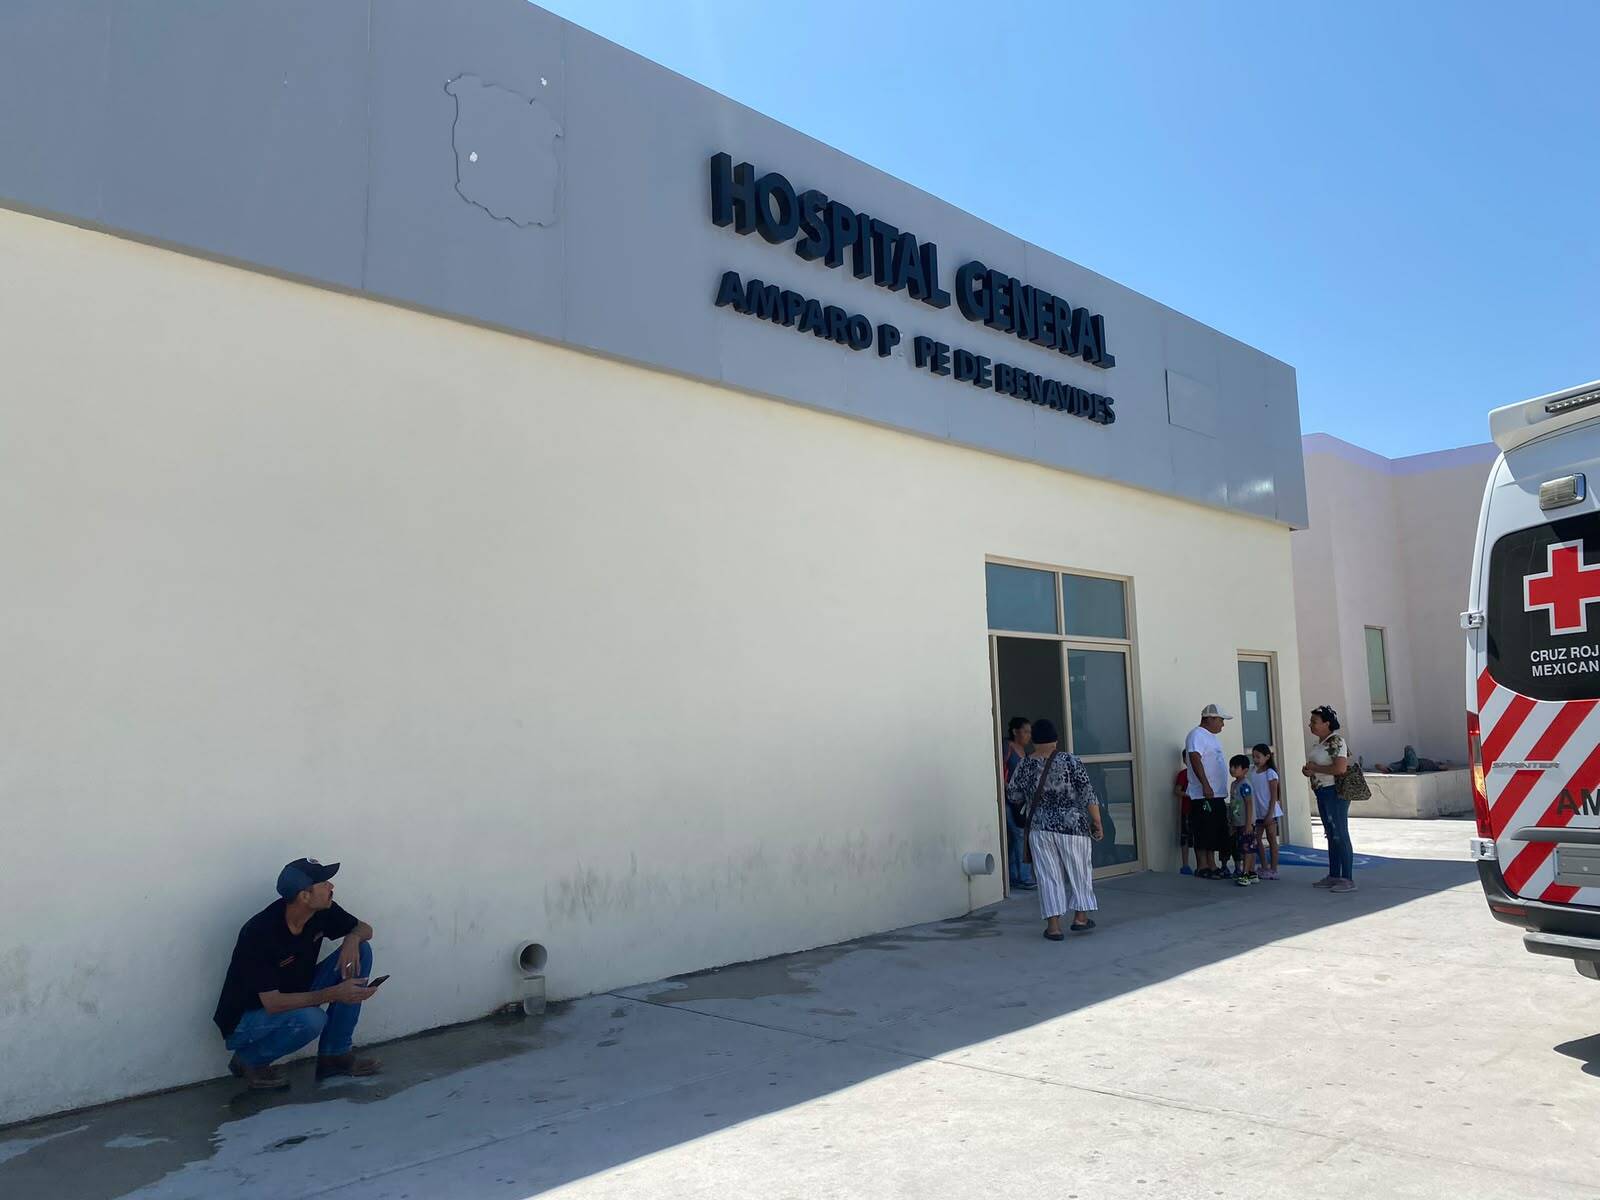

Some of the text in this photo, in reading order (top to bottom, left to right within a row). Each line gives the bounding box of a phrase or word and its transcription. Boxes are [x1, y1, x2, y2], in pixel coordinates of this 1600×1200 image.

[711, 152, 1116, 369] HOSPITAL GENERAL
[715, 271, 873, 351] AMPARO
[953, 349, 992, 389] DE
[995, 363, 1116, 425] BENAVIDES
[1530, 645, 1600, 662] CRUZ ROJ
[1532, 660, 1600, 677] MEXICAN
[1492, 761, 1560, 769] SPRINTER
